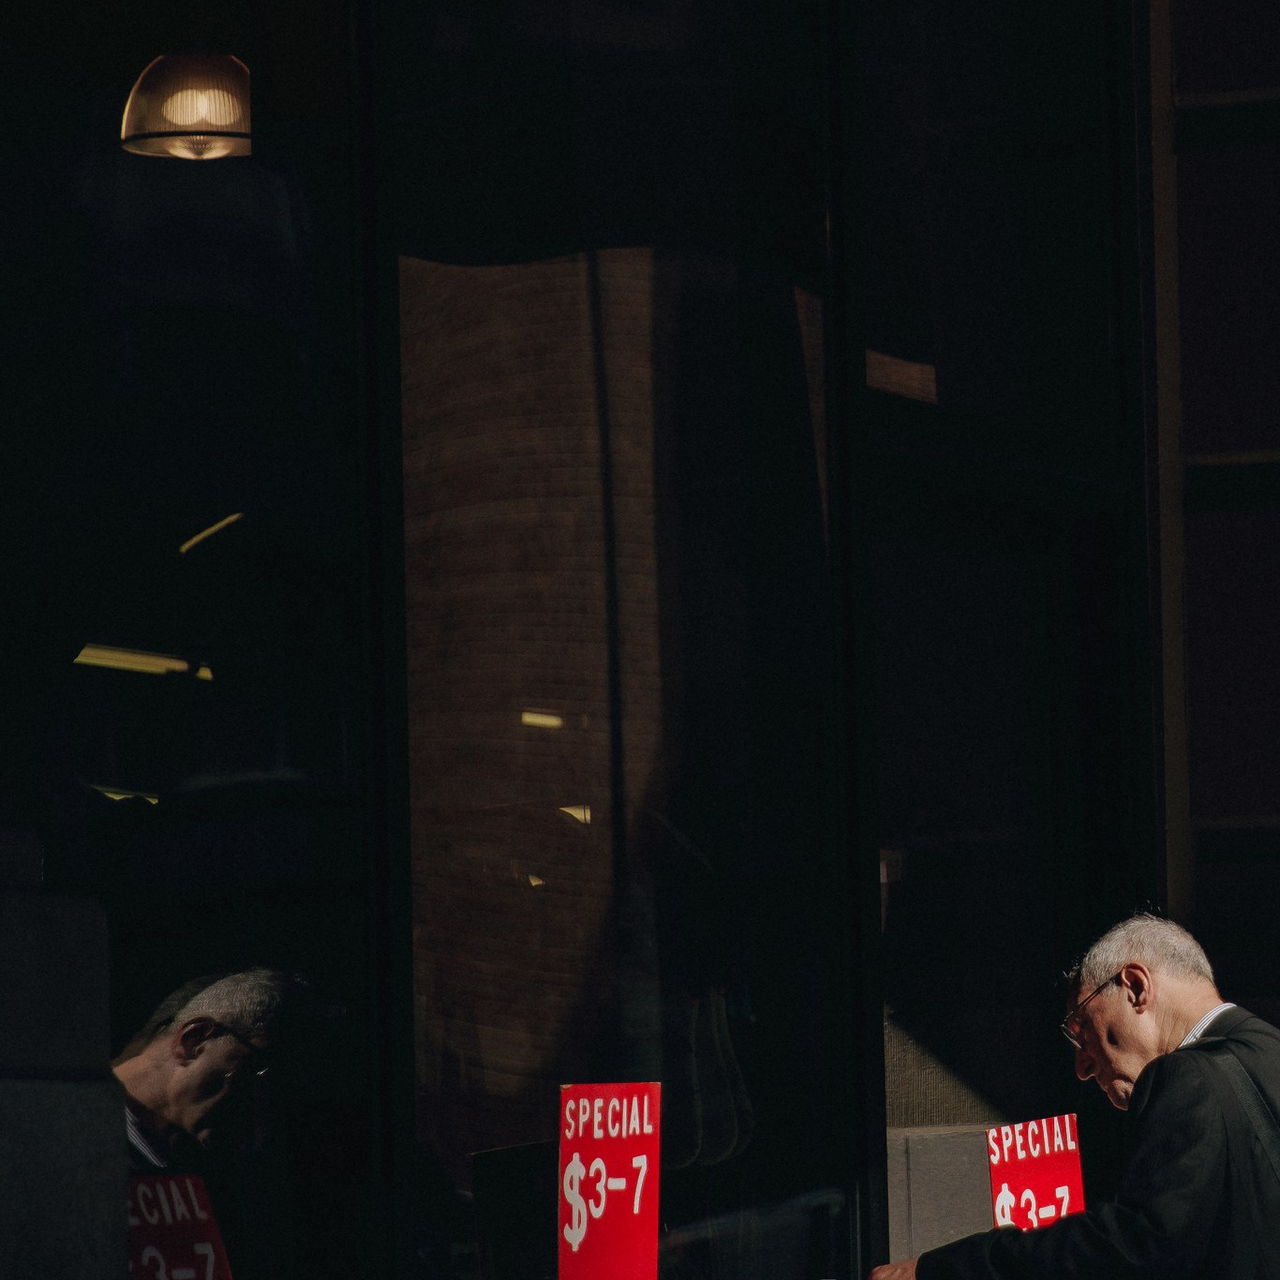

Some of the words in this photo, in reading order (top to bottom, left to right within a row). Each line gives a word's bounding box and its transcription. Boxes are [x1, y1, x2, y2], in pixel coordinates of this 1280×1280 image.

[565, 1095, 653, 1141] SPECIAL
[988, 1114, 1076, 1164] SPECIAL
[563, 1152, 649, 1253] $3-7
